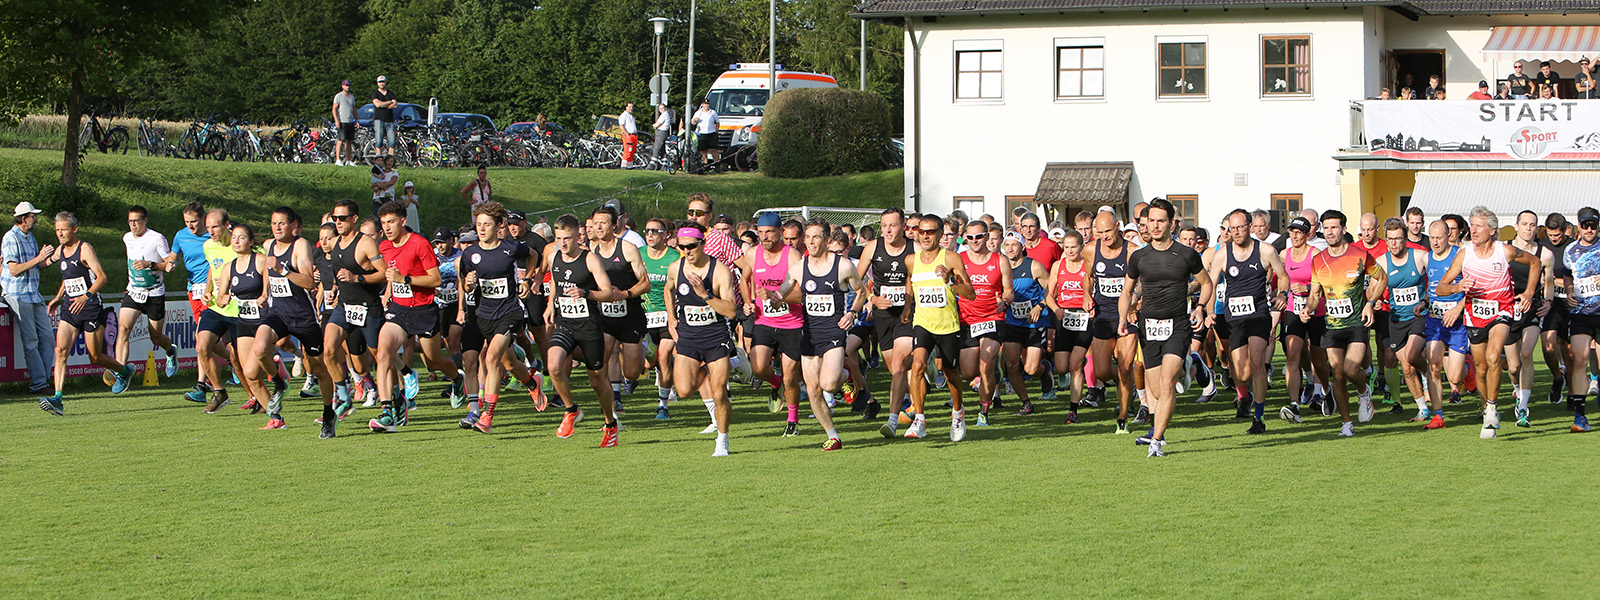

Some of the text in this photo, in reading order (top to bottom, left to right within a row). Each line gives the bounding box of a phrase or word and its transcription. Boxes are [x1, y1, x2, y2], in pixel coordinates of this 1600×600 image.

[1479, 102, 1577, 122] START
[970, 274, 989, 283] ASK
[67, 282, 85, 294] 2251
[270, 284, 288, 293] 2261
[393, 283, 410, 294] 2282
[1062, 280, 1081, 290] ASK
[1100, 284, 1123, 293] 2253
[1580, 283, 1600, 294] 2186
[482, 286, 505, 294] 2247
[883, 293, 905, 302] 209
[920, 294, 944, 303] 2205
[1395, 293, 1417, 303] 2187
[240, 307, 256, 315] 2249
[562, 304, 586, 314] 2212
[604, 304, 625, 313] 2154
[808, 303, 832, 312] 2257
[1231, 304, 1252, 313] 2121
[1329, 305, 1352, 314] 2178
[1474, 306, 1496, 316] 2361
[347, 310, 364, 321] 384
[688, 312, 714, 322] 2264
[646, 316, 665, 325] 2134
[1064, 318, 1086, 327] 2337
[972, 321, 994, 334] 2328
[1147, 327, 1170, 336] 2266
